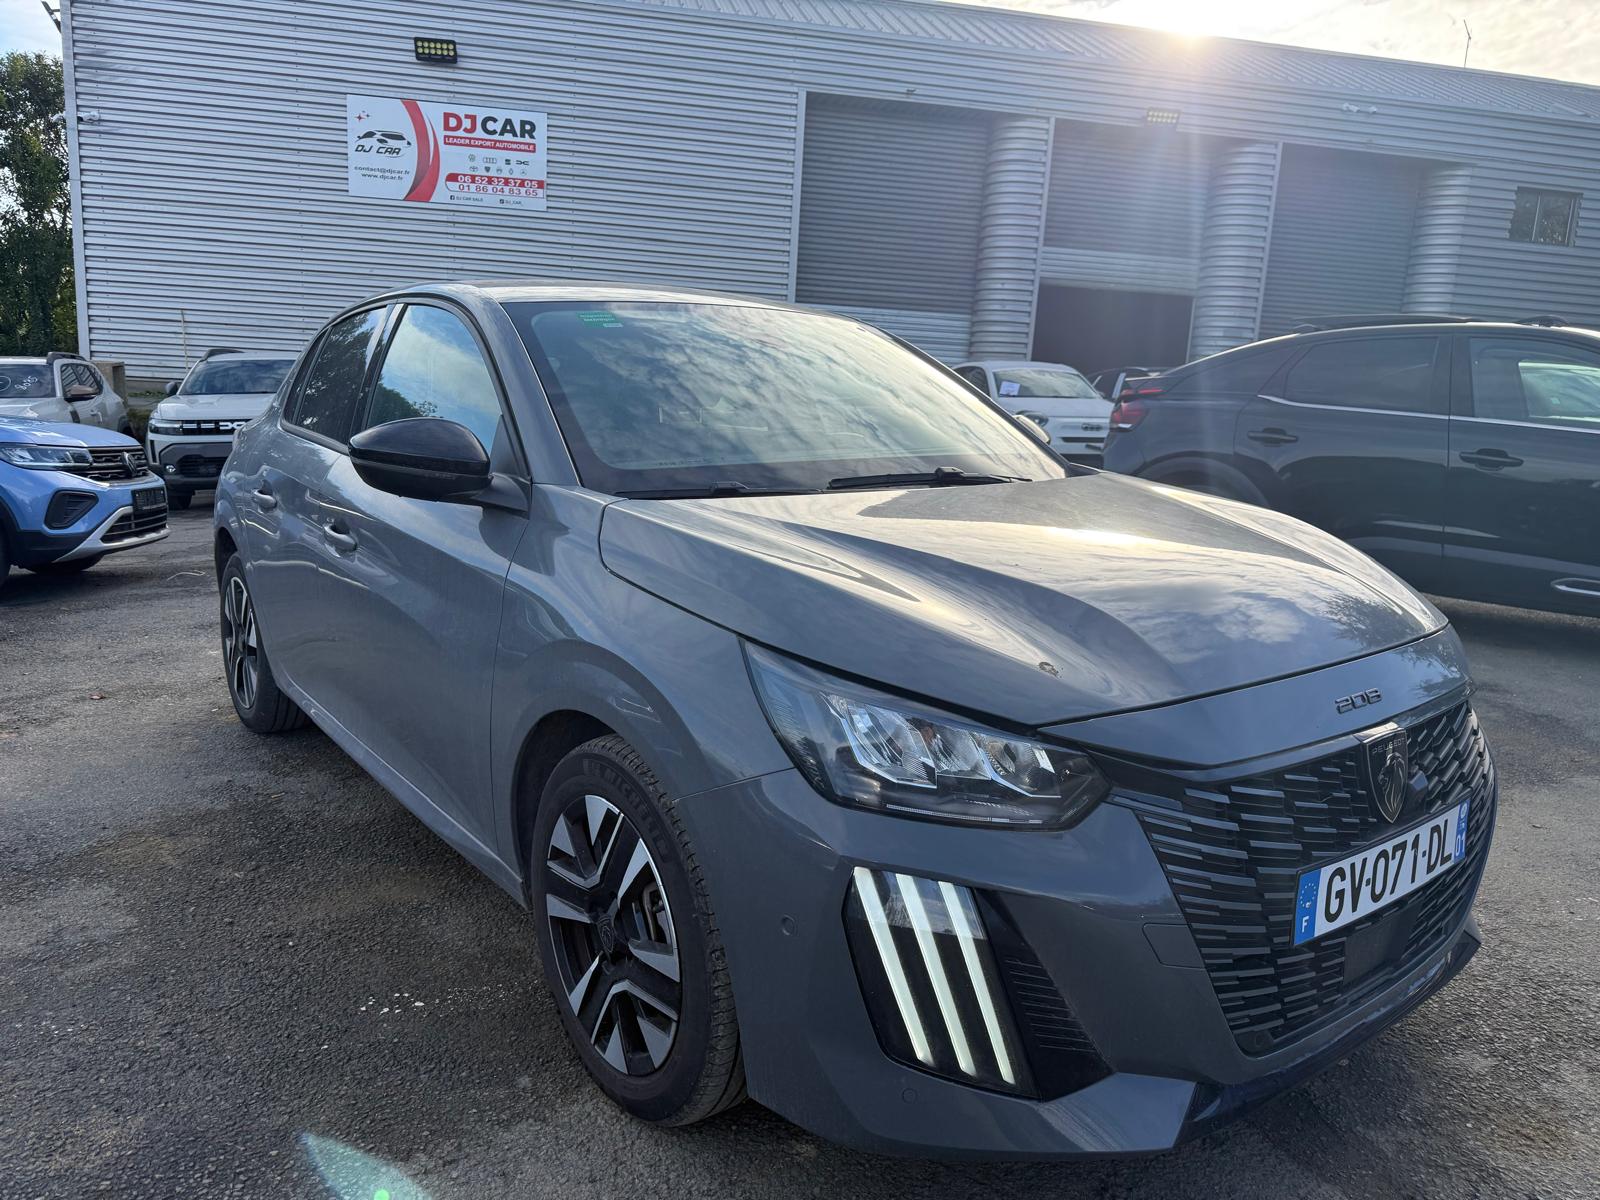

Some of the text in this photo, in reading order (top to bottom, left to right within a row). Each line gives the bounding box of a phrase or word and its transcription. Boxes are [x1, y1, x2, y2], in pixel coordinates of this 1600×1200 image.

[443, 111, 536, 139] DJ CAR
[354, 144, 402, 156] DJ CAR
[445, 137, 535, 151] LEADER EXPORT AUTOMOBILE
[354, 166, 410, 176] contact@djcar.fr
[361, 172, 403, 180] www.djcar.fr
[457, 174, 538, 188] 06 52 32 37 05
[458, 183, 538, 196] 01 86 04 83 65
[1334, 687, 1383, 714] 208
[1372, 737, 1406, 754] PEUGEOT
[1455, 831, 1467, 857] 01
[1324, 818, 1453, 923] GV-071-DL
[1301, 916, 1310, 933] F
